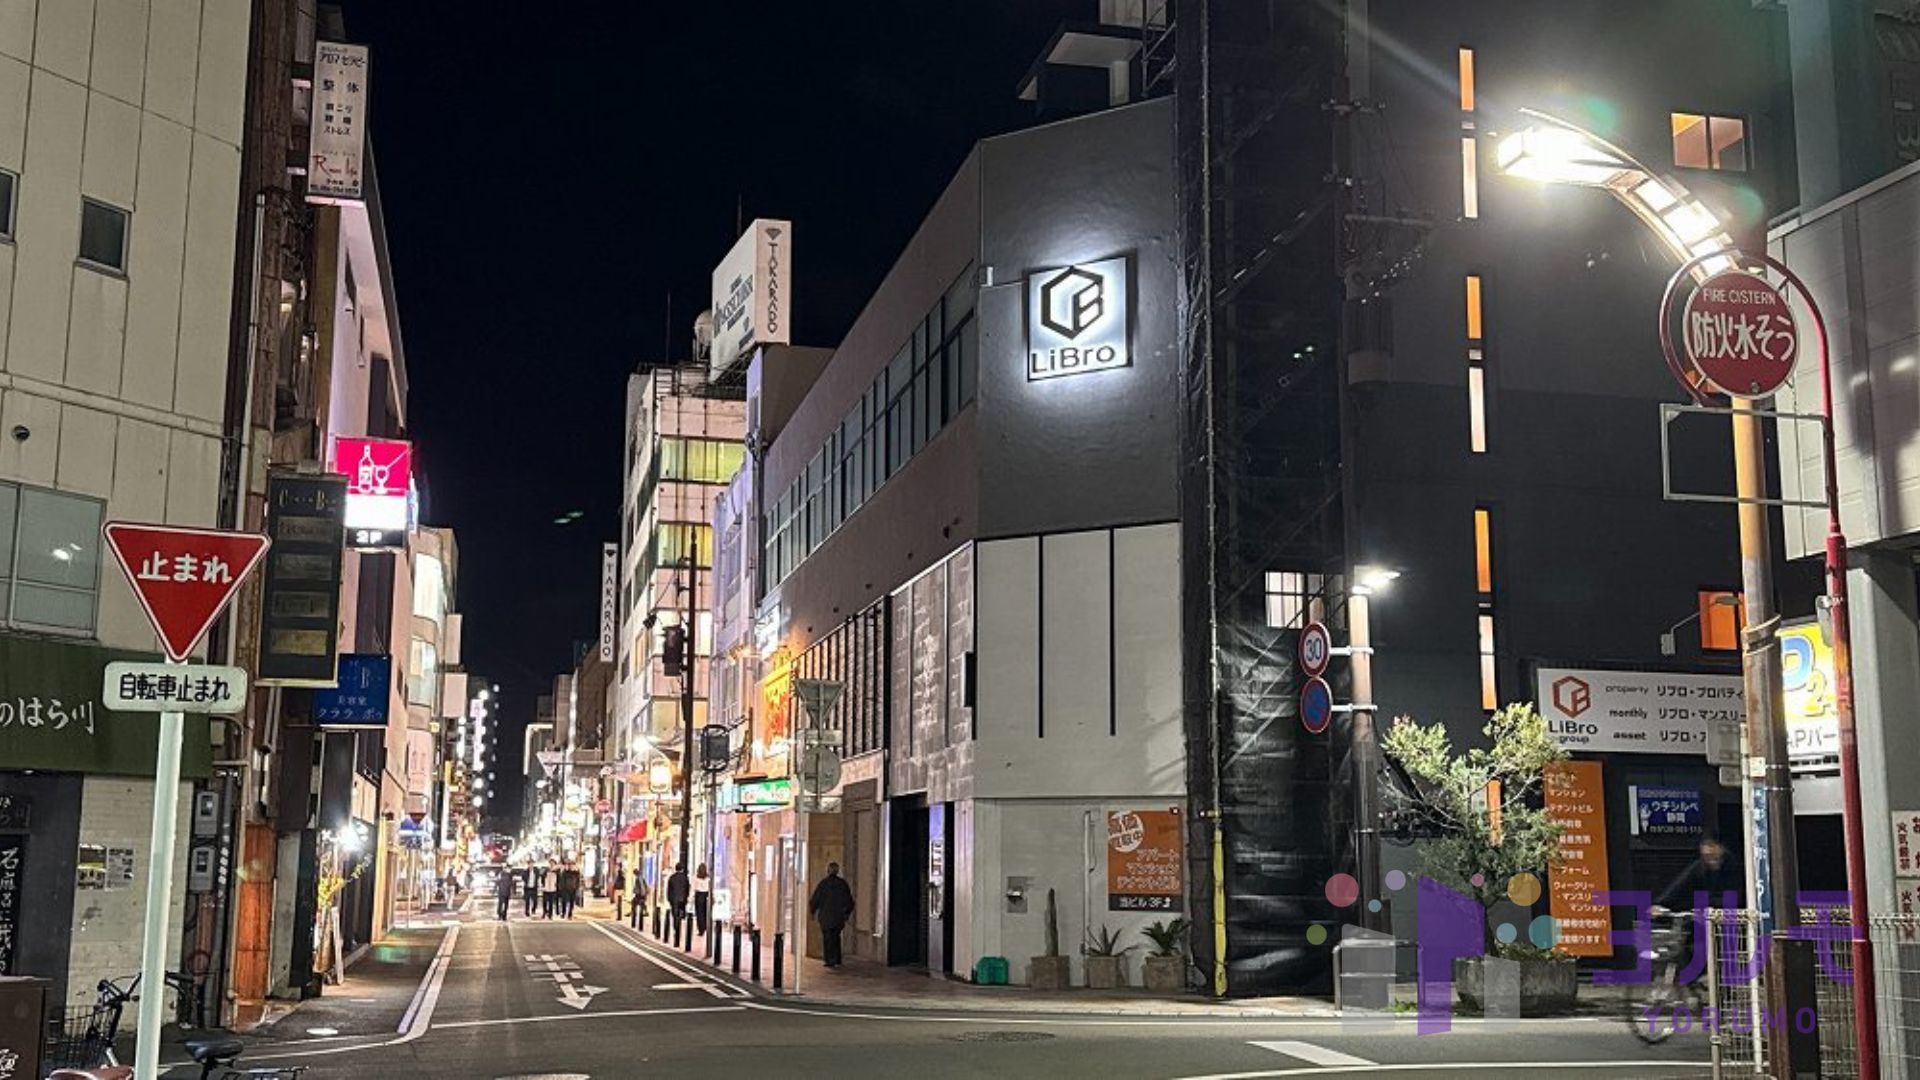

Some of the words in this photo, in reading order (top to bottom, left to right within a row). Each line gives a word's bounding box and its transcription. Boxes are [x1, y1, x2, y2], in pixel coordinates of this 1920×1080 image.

[767, 242, 778, 334] TAKARADO
[1703, 288, 1727, 303] FIRE
[1728, 289, 1776, 305] CISTERN
[1692, 311, 1795, 361] 防火水そう
[1031, 346, 1115, 373] LiBro
[355, 530, 383, 545] 2F
[137, 551, 233, 584] 止まれ
[602, 564, 613, 656] TAKARADO
[1306, 638, 1323, 661] 30
[120, 672, 231, 702] 自転車止まれ
[1609, 708, 1649, 719] monthly
[1613, 731, 1647, 741] asset
